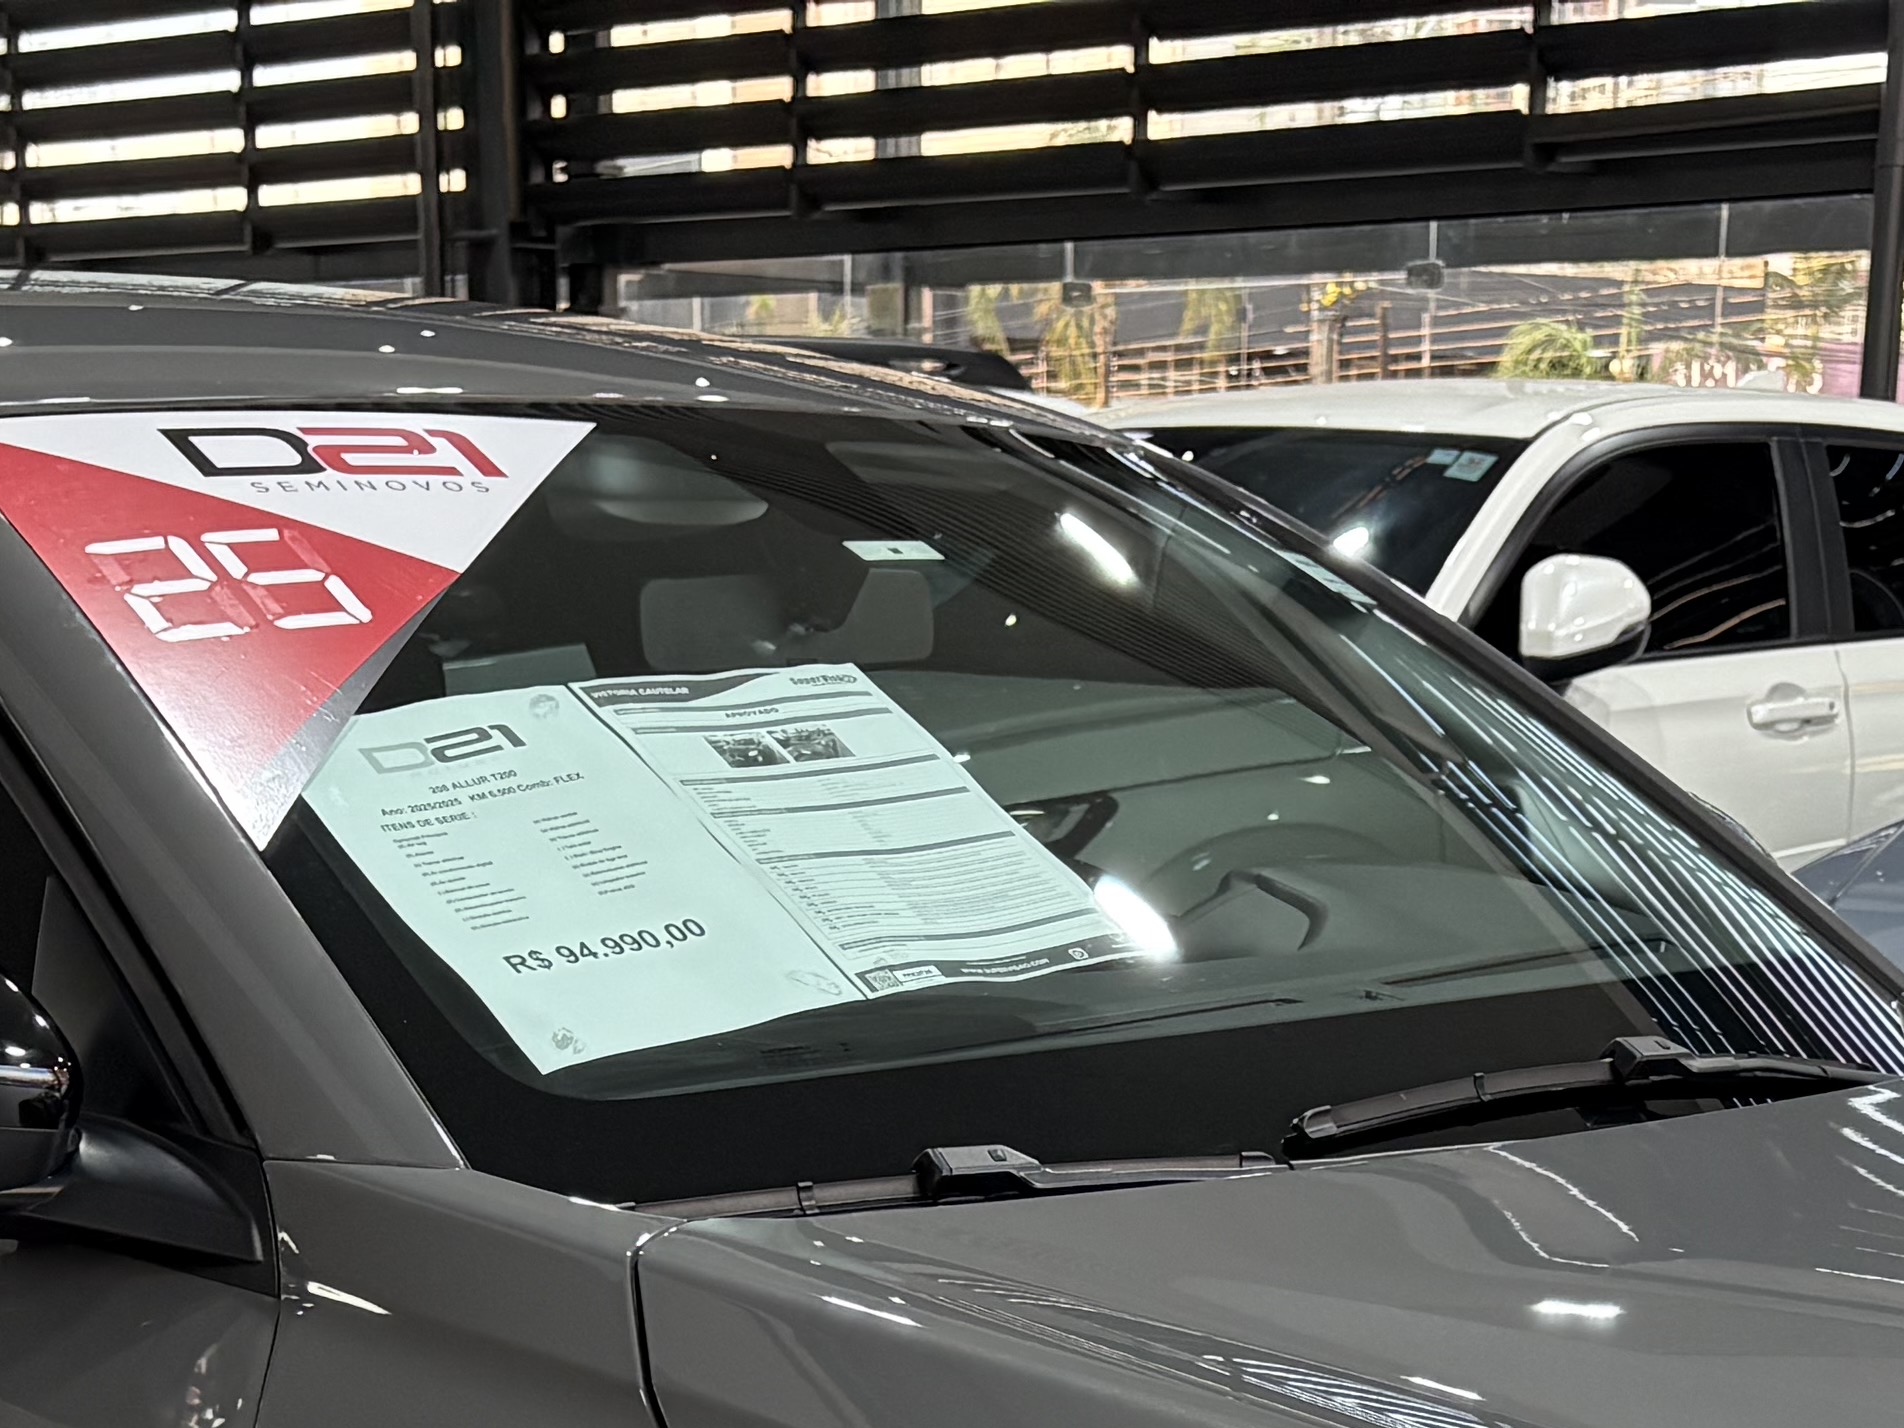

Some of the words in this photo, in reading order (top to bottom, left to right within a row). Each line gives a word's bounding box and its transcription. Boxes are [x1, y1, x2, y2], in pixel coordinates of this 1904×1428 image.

[156, 428, 509, 478] D21
[250, 479, 491, 494] SEMINOVOS
[85, 528, 373, 642] 25
[358, 724, 527, 774] D21
[452, 775, 490, 791] ALLUR
[468, 790, 488, 803] KM
[554, 772, 585, 785] FLEX
[380, 820, 415, 833] ITENS
[417, 817, 434, 828] DE
[503, 949, 553, 974] R$
[555, 917, 706, 965] 94.990,00
